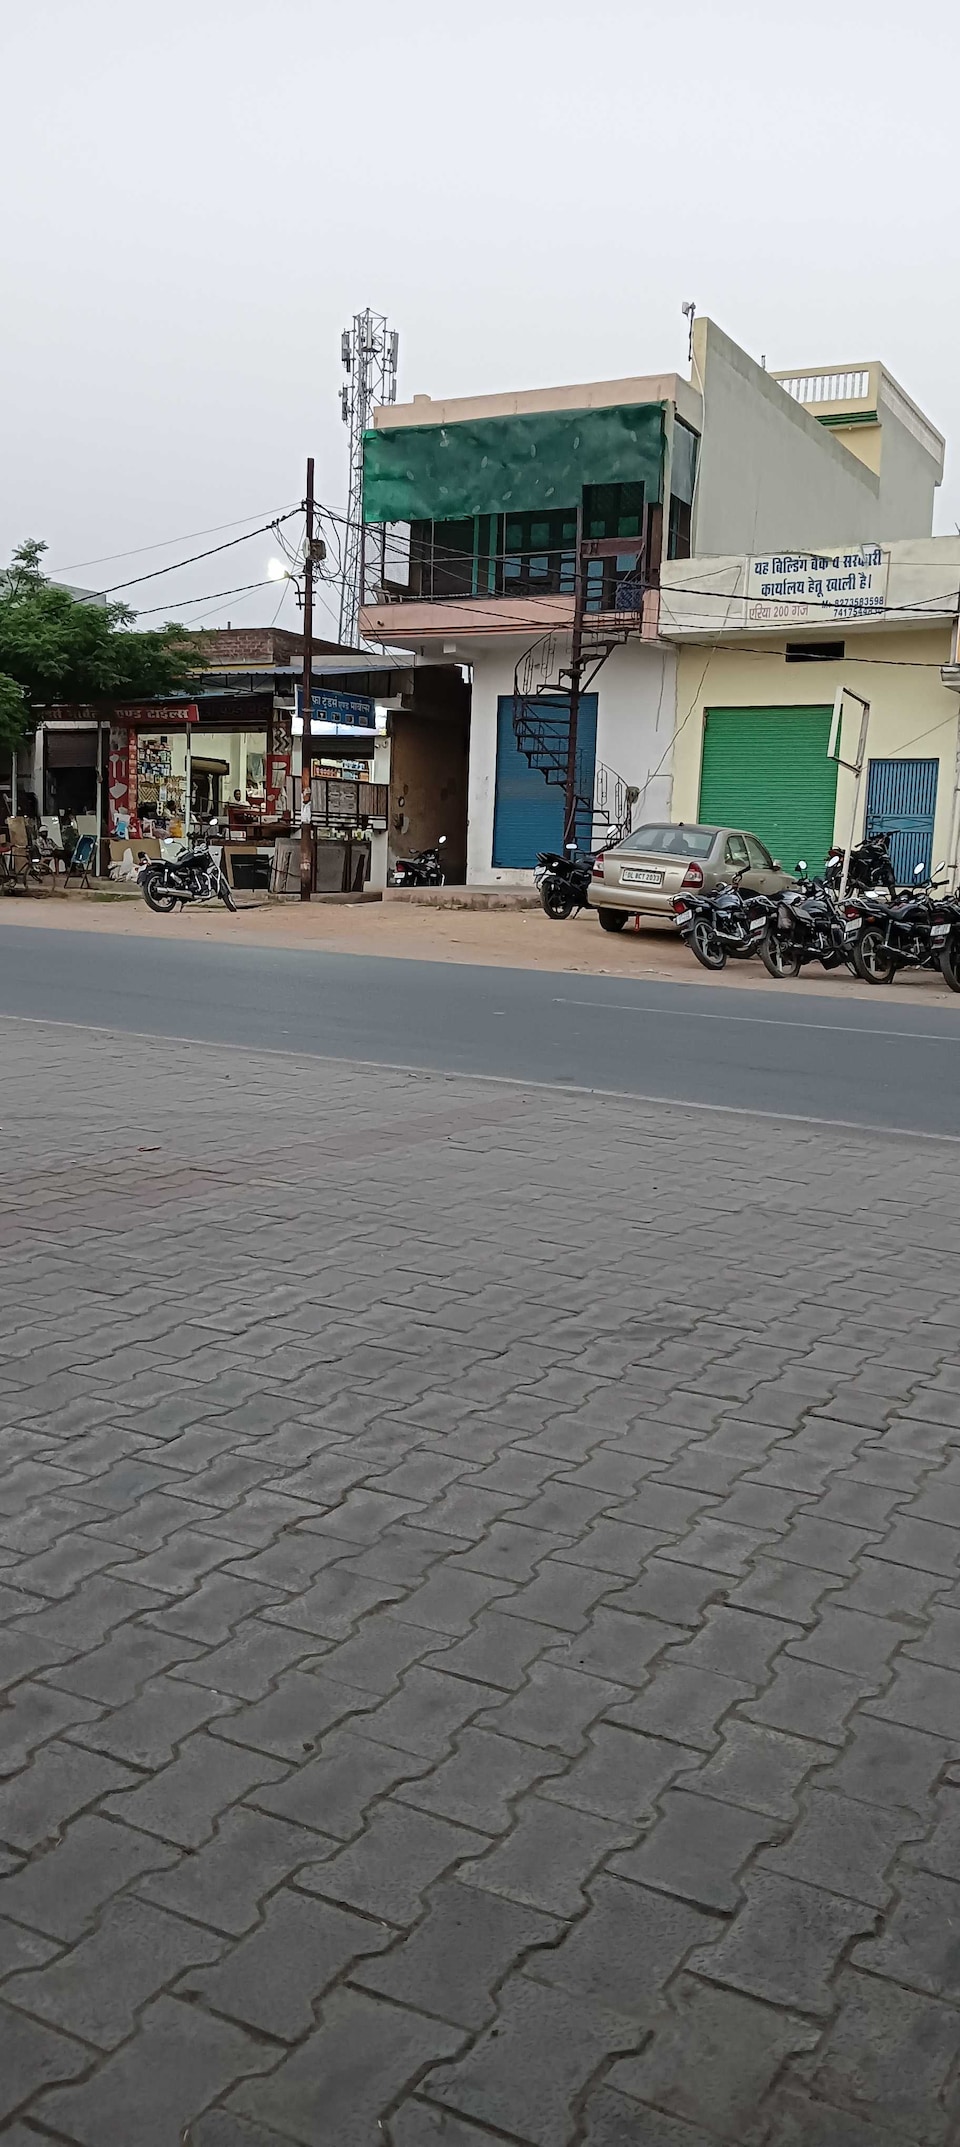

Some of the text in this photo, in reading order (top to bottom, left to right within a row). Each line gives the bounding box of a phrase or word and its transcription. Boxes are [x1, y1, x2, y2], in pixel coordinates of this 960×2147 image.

[754, 562, 769, 575] यह
[761, 578, 805, 597] कार्यालय
[826, 573, 856, 592] खाली
[749, 602, 808, 619] एरिया 200 गज
[147, 706, 189, 720] टाईल्स
